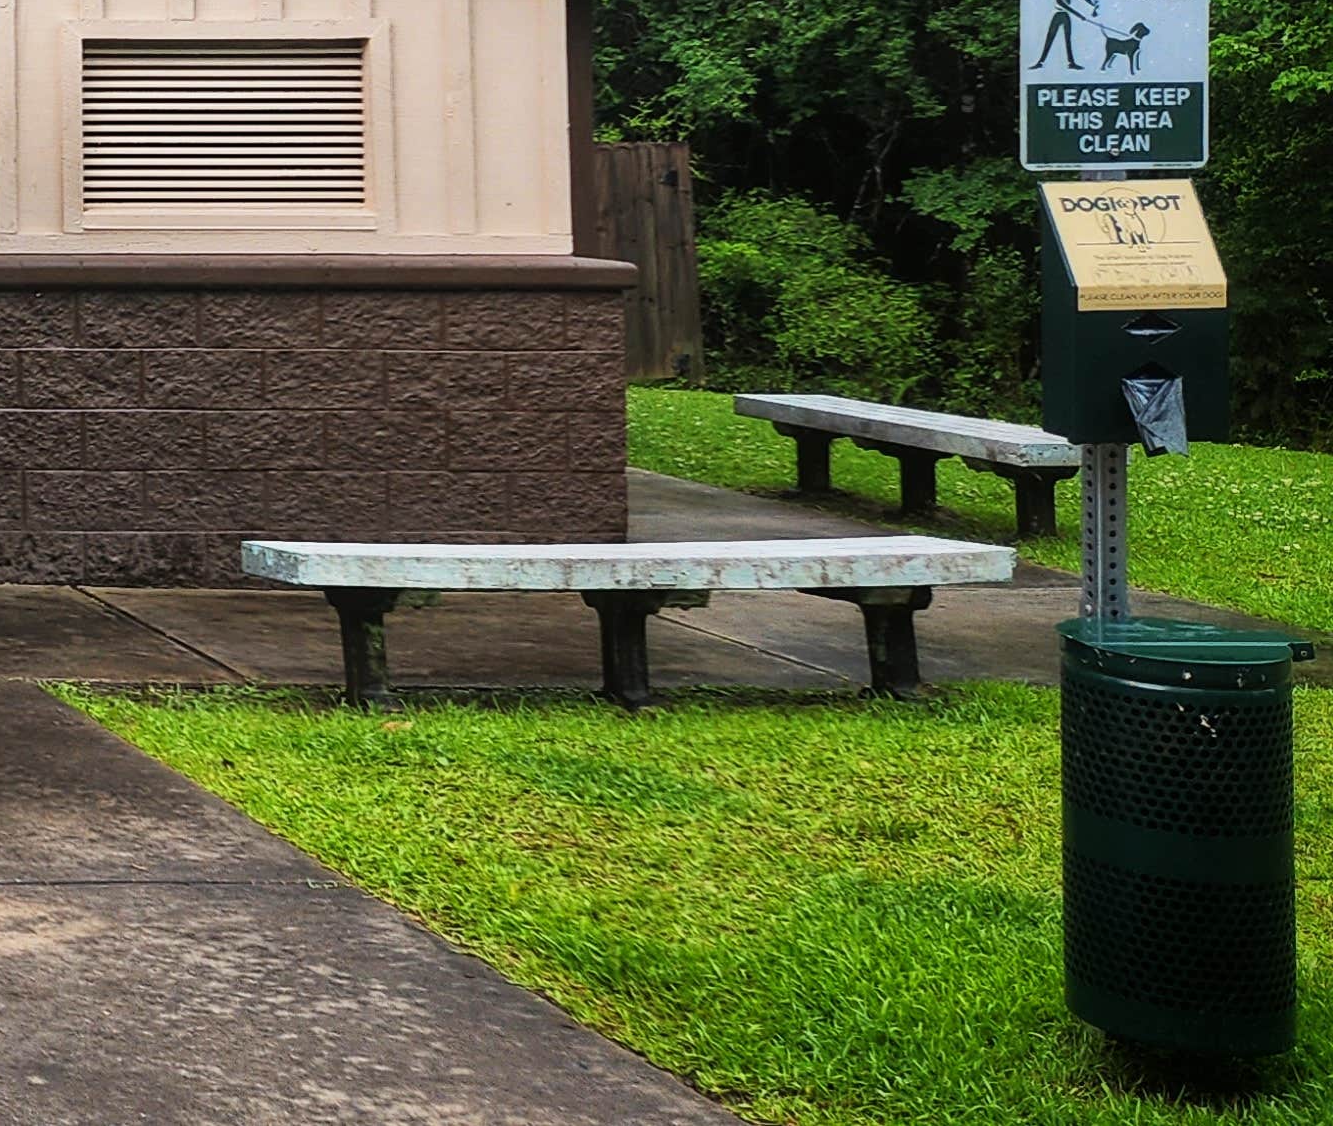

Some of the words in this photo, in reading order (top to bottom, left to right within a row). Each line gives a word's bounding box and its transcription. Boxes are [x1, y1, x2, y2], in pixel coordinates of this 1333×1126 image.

[1037, 89, 1120, 107] PLEASE
[1135, 88, 1191, 106] KEEP
[1055, 113, 1104, 130] THIS
[1115, 112, 1173, 129] AREA
[1079, 134, 1150, 153] CLEAN
[1179, 291, 1201, 299] YOUR
